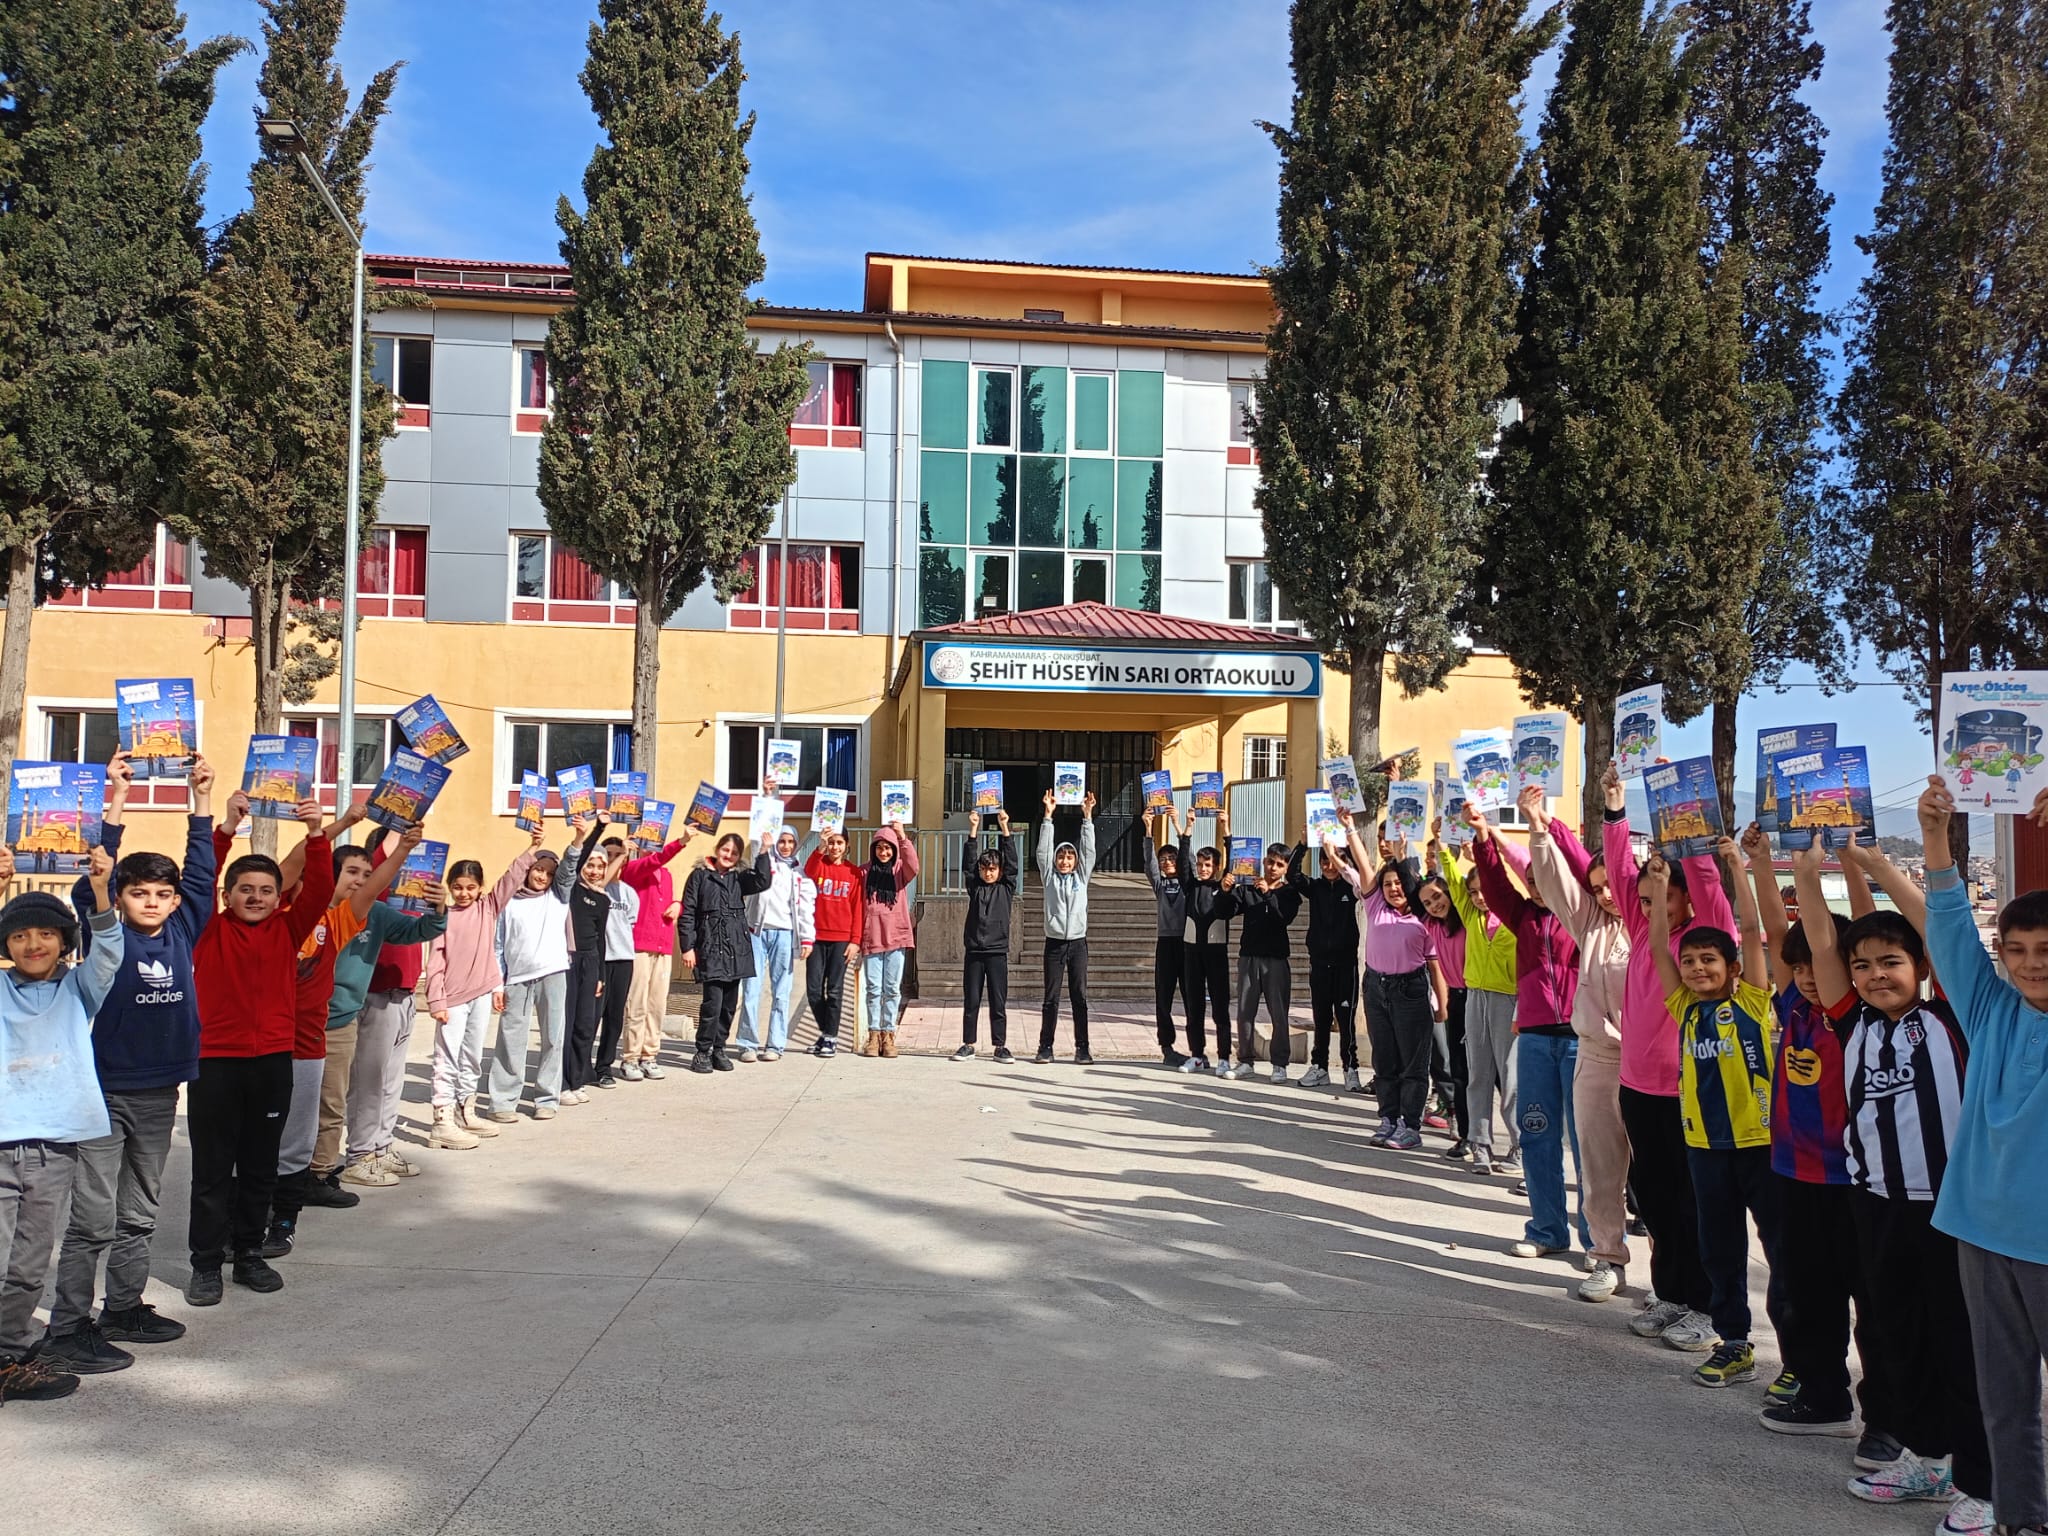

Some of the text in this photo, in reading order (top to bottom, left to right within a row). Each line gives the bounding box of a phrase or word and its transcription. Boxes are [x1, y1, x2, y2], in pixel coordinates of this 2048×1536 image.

[970, 650, 1047, 661] KAHRAMANMARAŞ
[970, 660, 1295, 686] ŞEHİT HÜSEYİN SARI ORTAOKULU
[136, 990, 183, 1004] adidas
[1743, 1039, 1759, 1070] PORT
